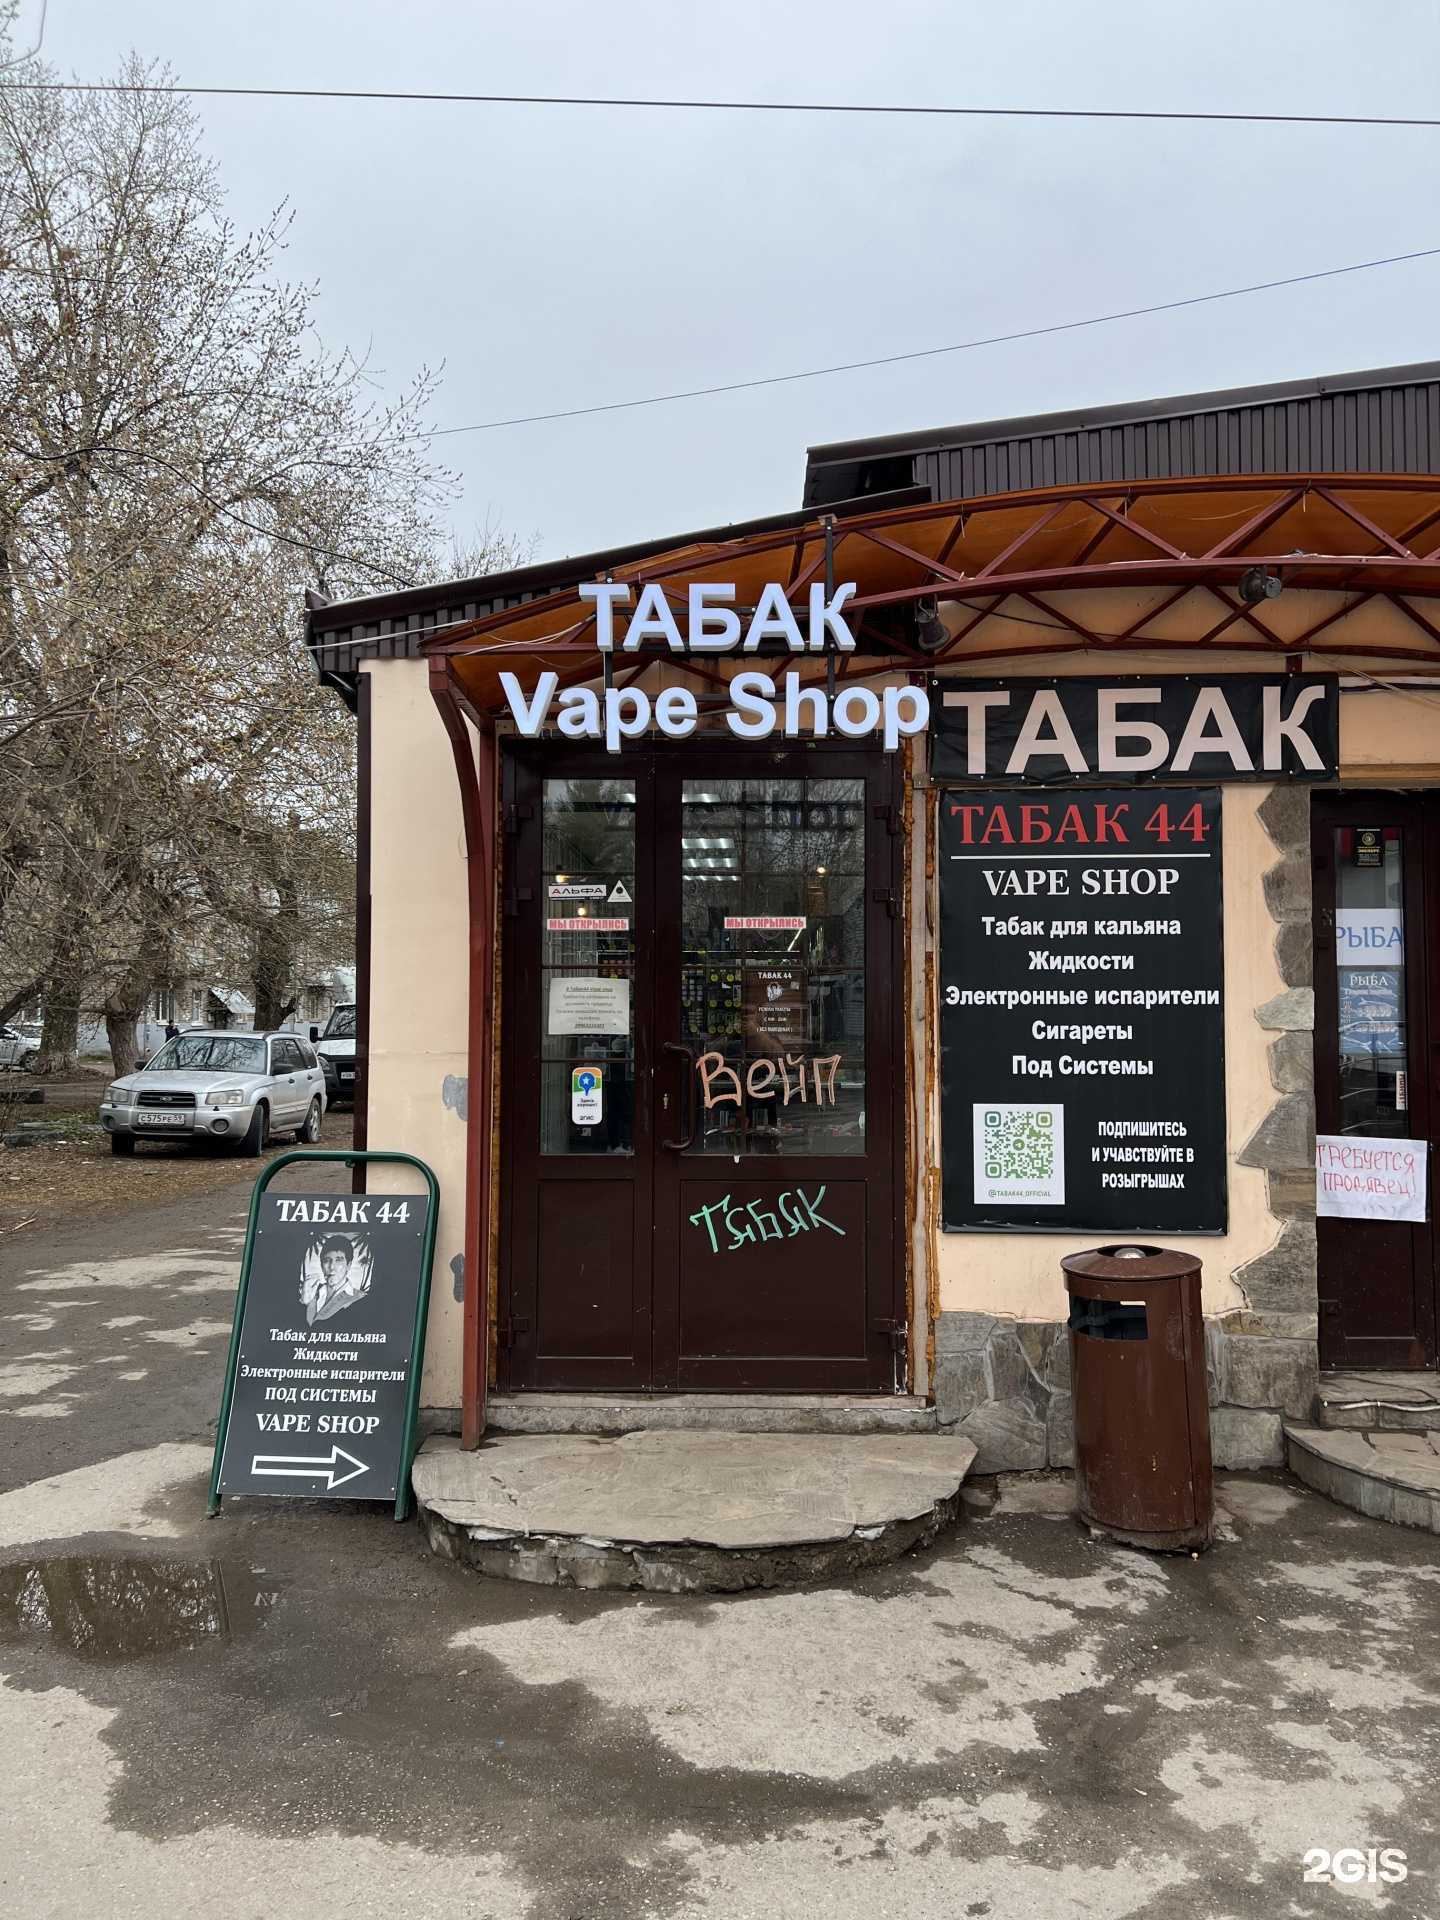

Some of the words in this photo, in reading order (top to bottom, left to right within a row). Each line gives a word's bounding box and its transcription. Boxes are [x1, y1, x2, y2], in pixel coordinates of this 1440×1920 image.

[579, 582, 857, 652] ТАБАК
[498, 672, 698, 755] Vape
[726, 671, 930, 754] Shop
[943, 684, 1327, 775] ТАБАК
[951, 803, 1130, 845] ТАБАК
[1144, 803, 1211, 842] 44
[552, 887, 603, 895] АЛЬФА
[982, 869, 1070, 896] VAPE
[1081, 868, 1180, 895] SHOP
[549, 919, 566, 929] МЫ
[726, 918, 743, 928] МЫ
[746, 918, 804, 928] ОТКРЫЛИСЬ
[981, 916, 1044, 936] Табак
[1050, 920, 1087, 938] для
[1094, 918, 1181, 935] кальяна
[1335, 925, 1403, 949] РЫБА
[1028, 950, 1134, 973] Жидкости
[1350, 975, 1388, 986] РЫБА
[945, 985, 1088, 1009] Электронные
[1094, 988, 1220, 1009] испарители
[1031, 1020, 1133, 1044] Сигареты
[1012, 1055, 1053, 1077] Под
[1058, 1055, 1154, 1075] Системы
[1098, 1121, 1187, 1138] ПОДПИШИТЕСЬ
[1091, 1147, 1100, 1162] И
[1103, 1145, 1184, 1163] УЧАВСТВУЙТЕ
[1186, 1147, 1194, 1162] В
[1102, 1173, 1185, 1188] РОЗЫГРЫШАХ
[276, 1199, 370, 1223] ТАБАК
[376, 1201, 410, 1224] 44
[269, 1328, 307, 1342] Табак
[308, 1332, 332, 1344] для
[335, 1331, 387, 1344] кальяна
[293, 1347, 358, 1363] Жидкости
[240, 1365, 328, 1381] Электронные
[330, 1369, 406, 1383] испарители
[264, 1387, 297, 1403] ПОД
[300, 1388, 377, 1404] СИСТЕМЫ
[255, 1413, 311, 1433] VAPE
[317, 1414, 380, 1435] SHOP
